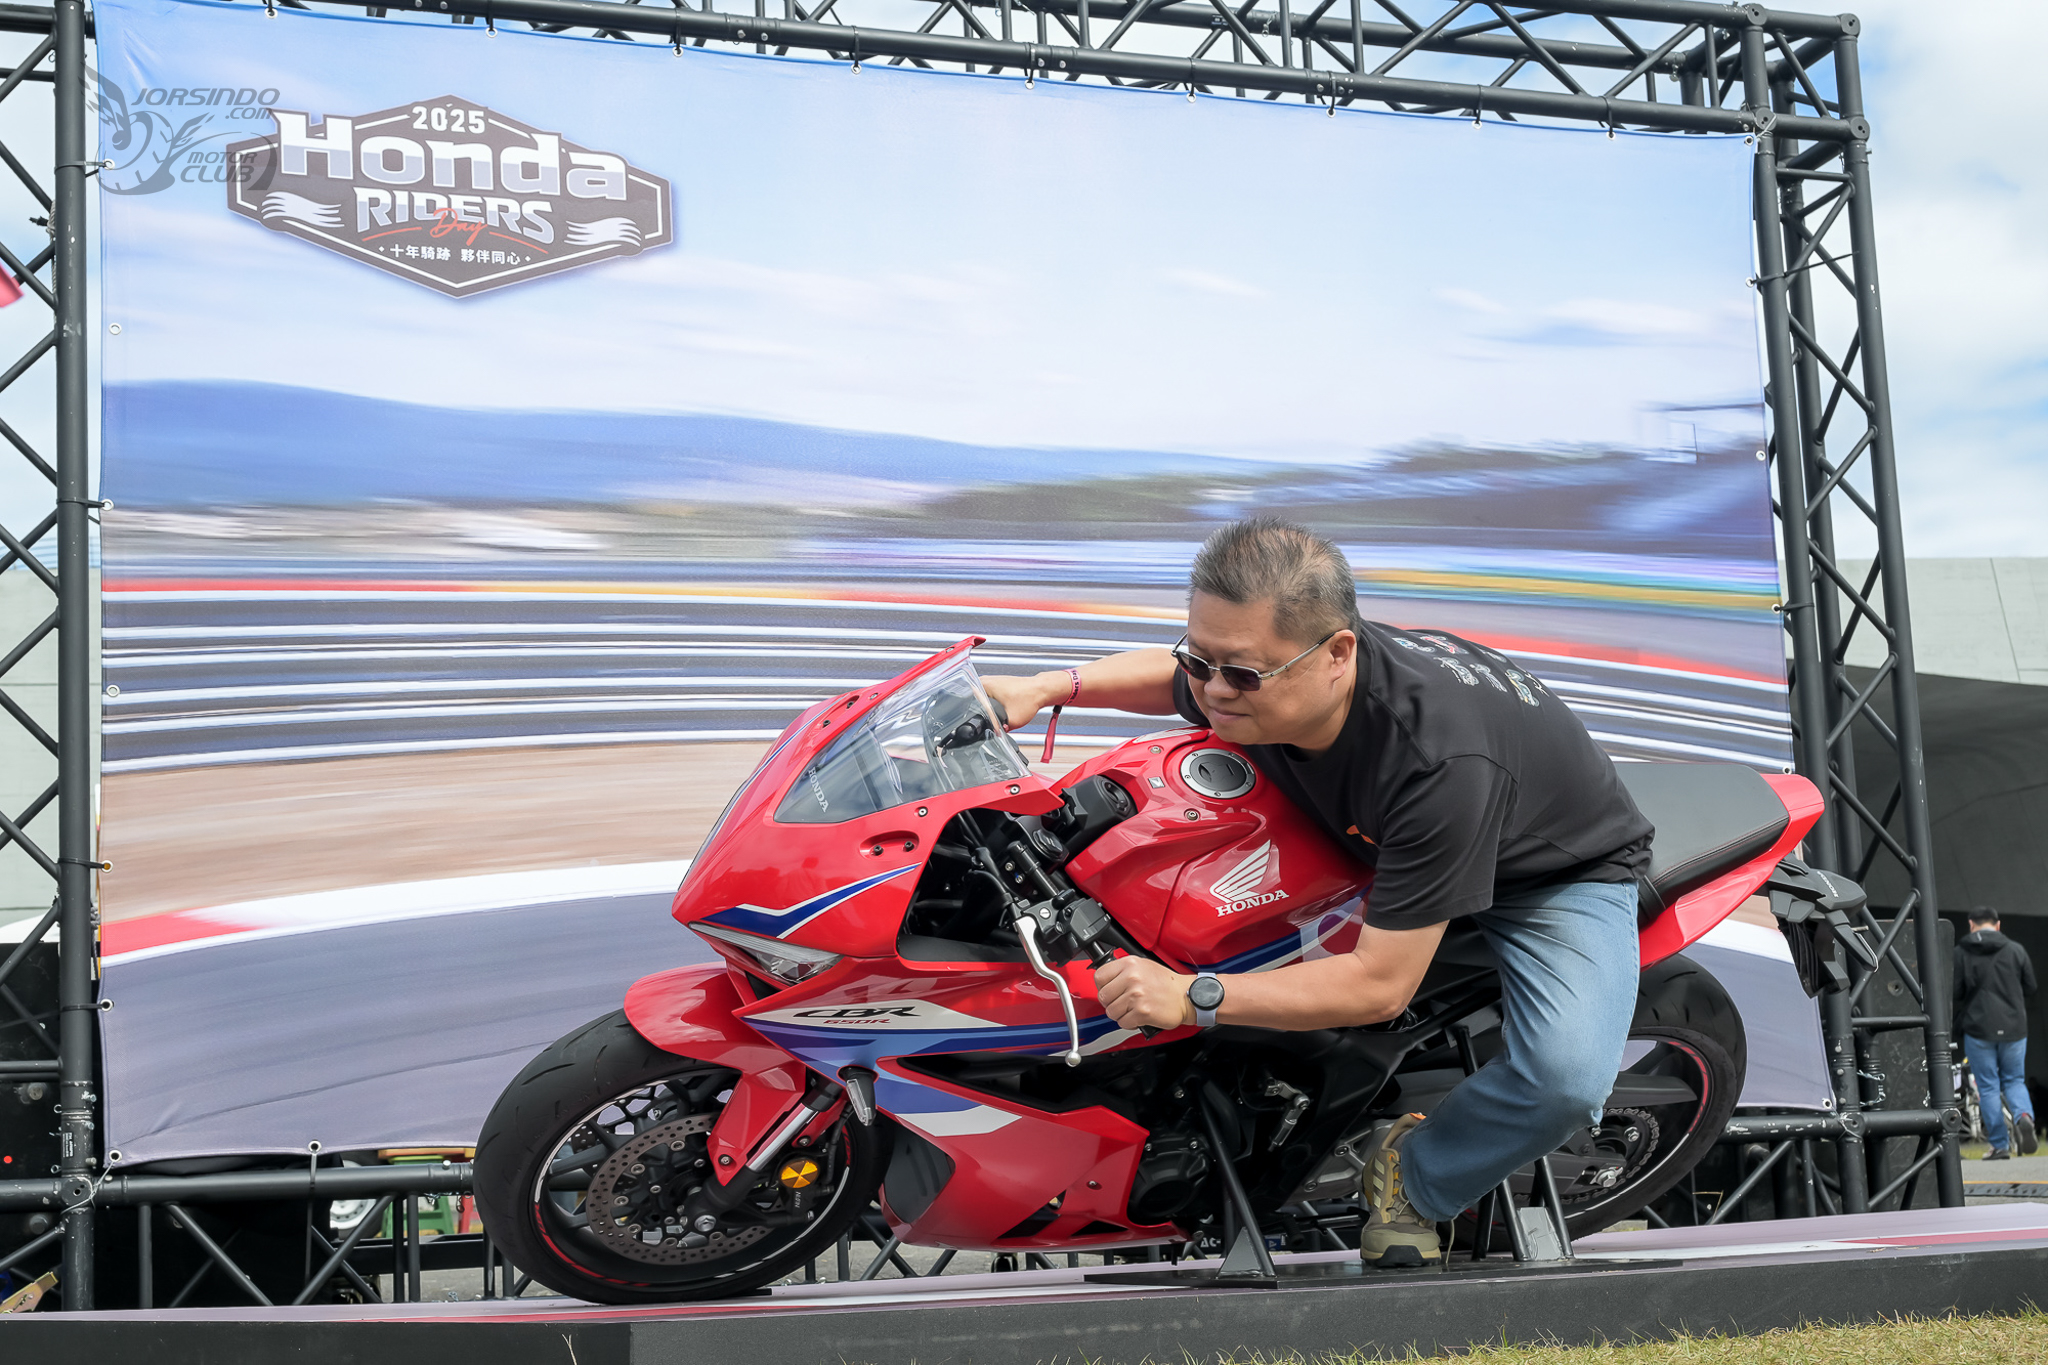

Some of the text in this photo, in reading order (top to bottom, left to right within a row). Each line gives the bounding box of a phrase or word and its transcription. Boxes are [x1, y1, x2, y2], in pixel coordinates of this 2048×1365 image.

[411, 105, 486, 134] 2025
[273, 111, 627, 200] Honda
[353, 186, 555, 245] RIDERS
[429, 207, 488, 247] Day
[390, 244, 521, 265] 十年騎跡 夥伴同心
[808, 766, 829, 813] HONDA
[1216, 890, 1289, 917] HONDA
[792, 1006, 922, 1018] CBR
